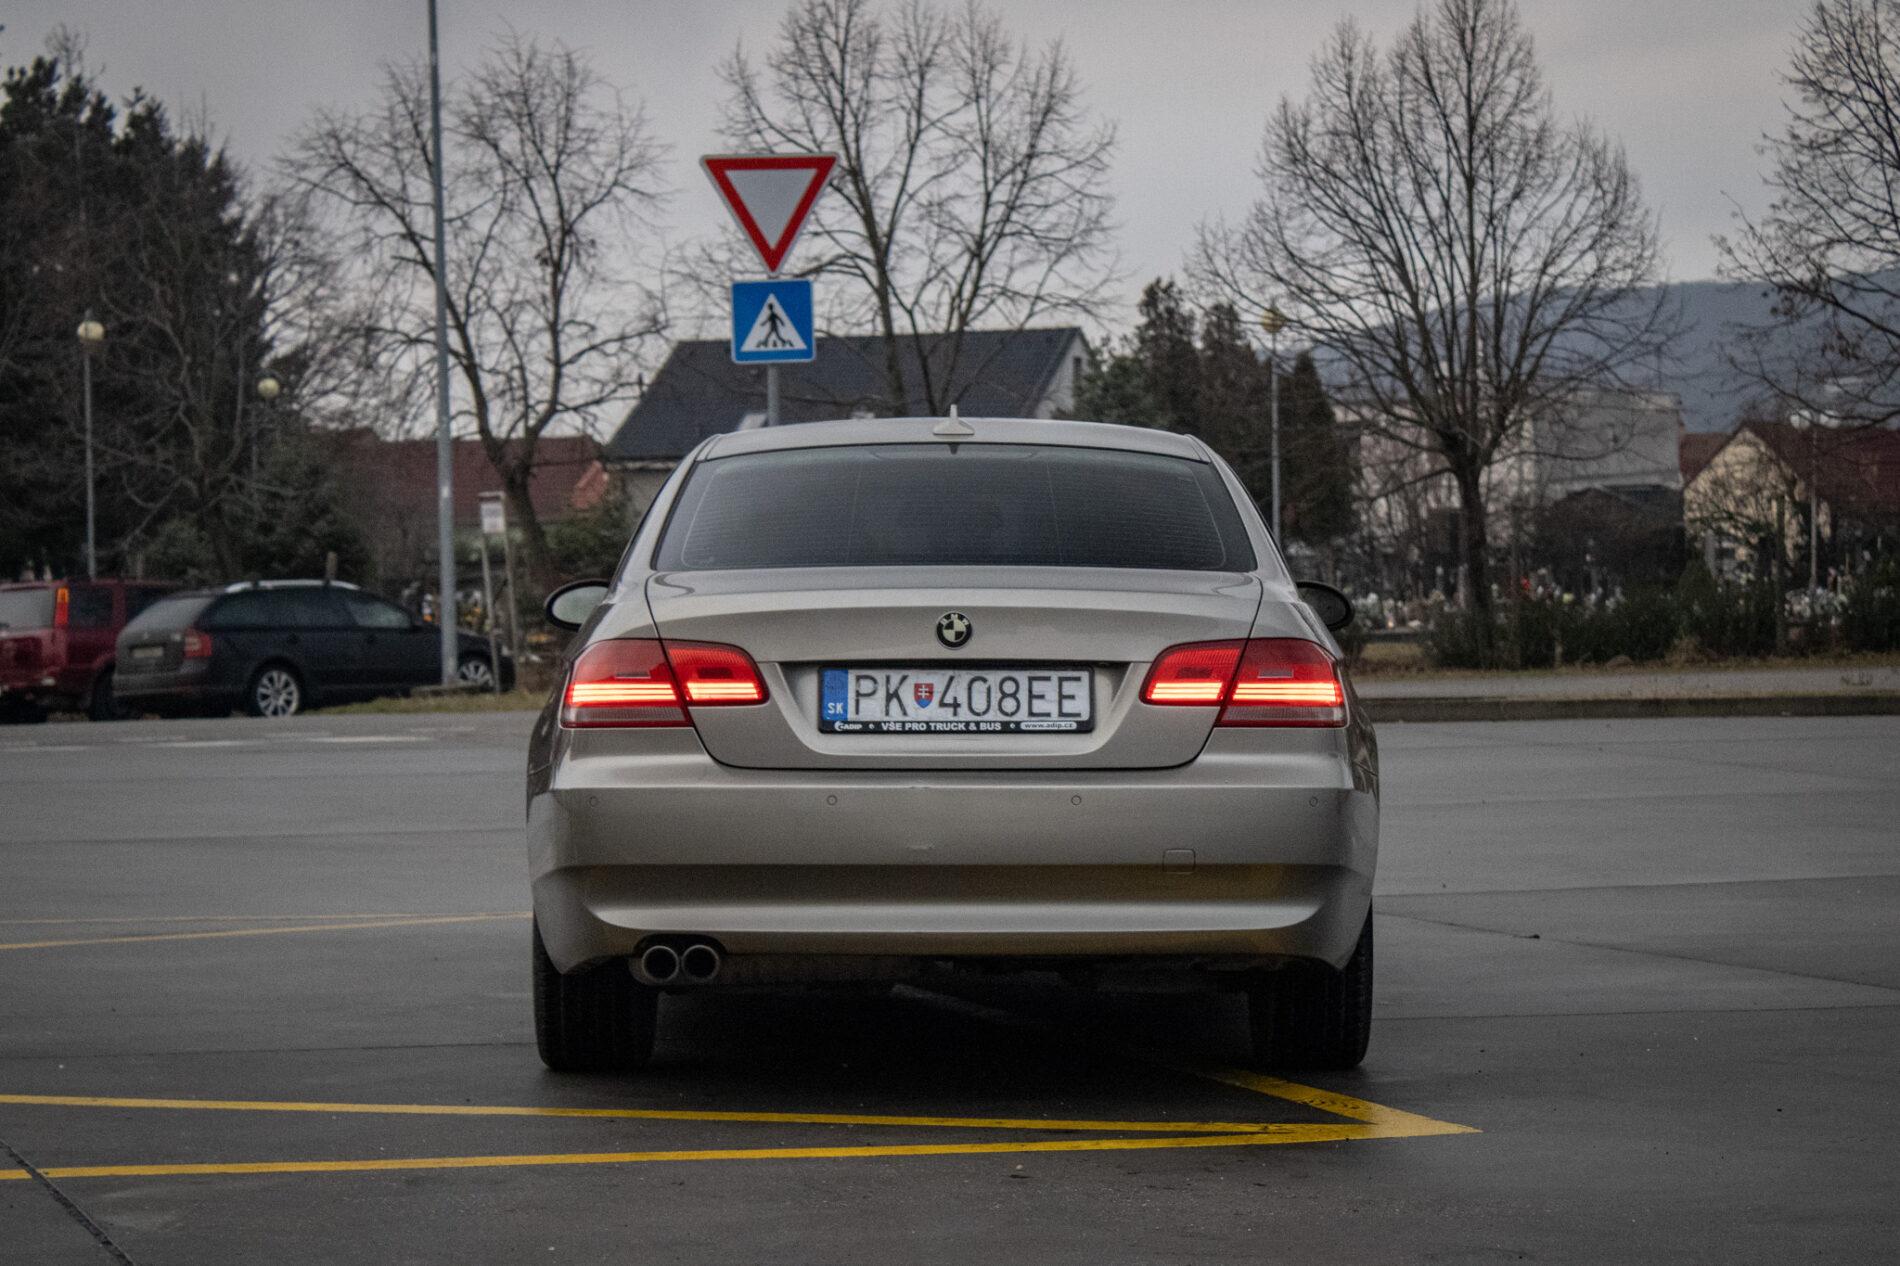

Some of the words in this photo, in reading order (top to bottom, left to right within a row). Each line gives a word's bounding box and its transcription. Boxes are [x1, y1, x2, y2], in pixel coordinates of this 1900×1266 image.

[855, 674, 909, 717] PK
[938, 675, 1082, 718] 408EE
[827, 702, 844, 714] SK
[881, 721, 903, 731] VŠE
[905, 722, 927, 731] PRO
[929, 722, 966, 731] TRUCK
[968, 722, 977, 731] &
[979, 722, 1002, 731] BUS
[1025, 722, 1073, 730] www.adip.cz
